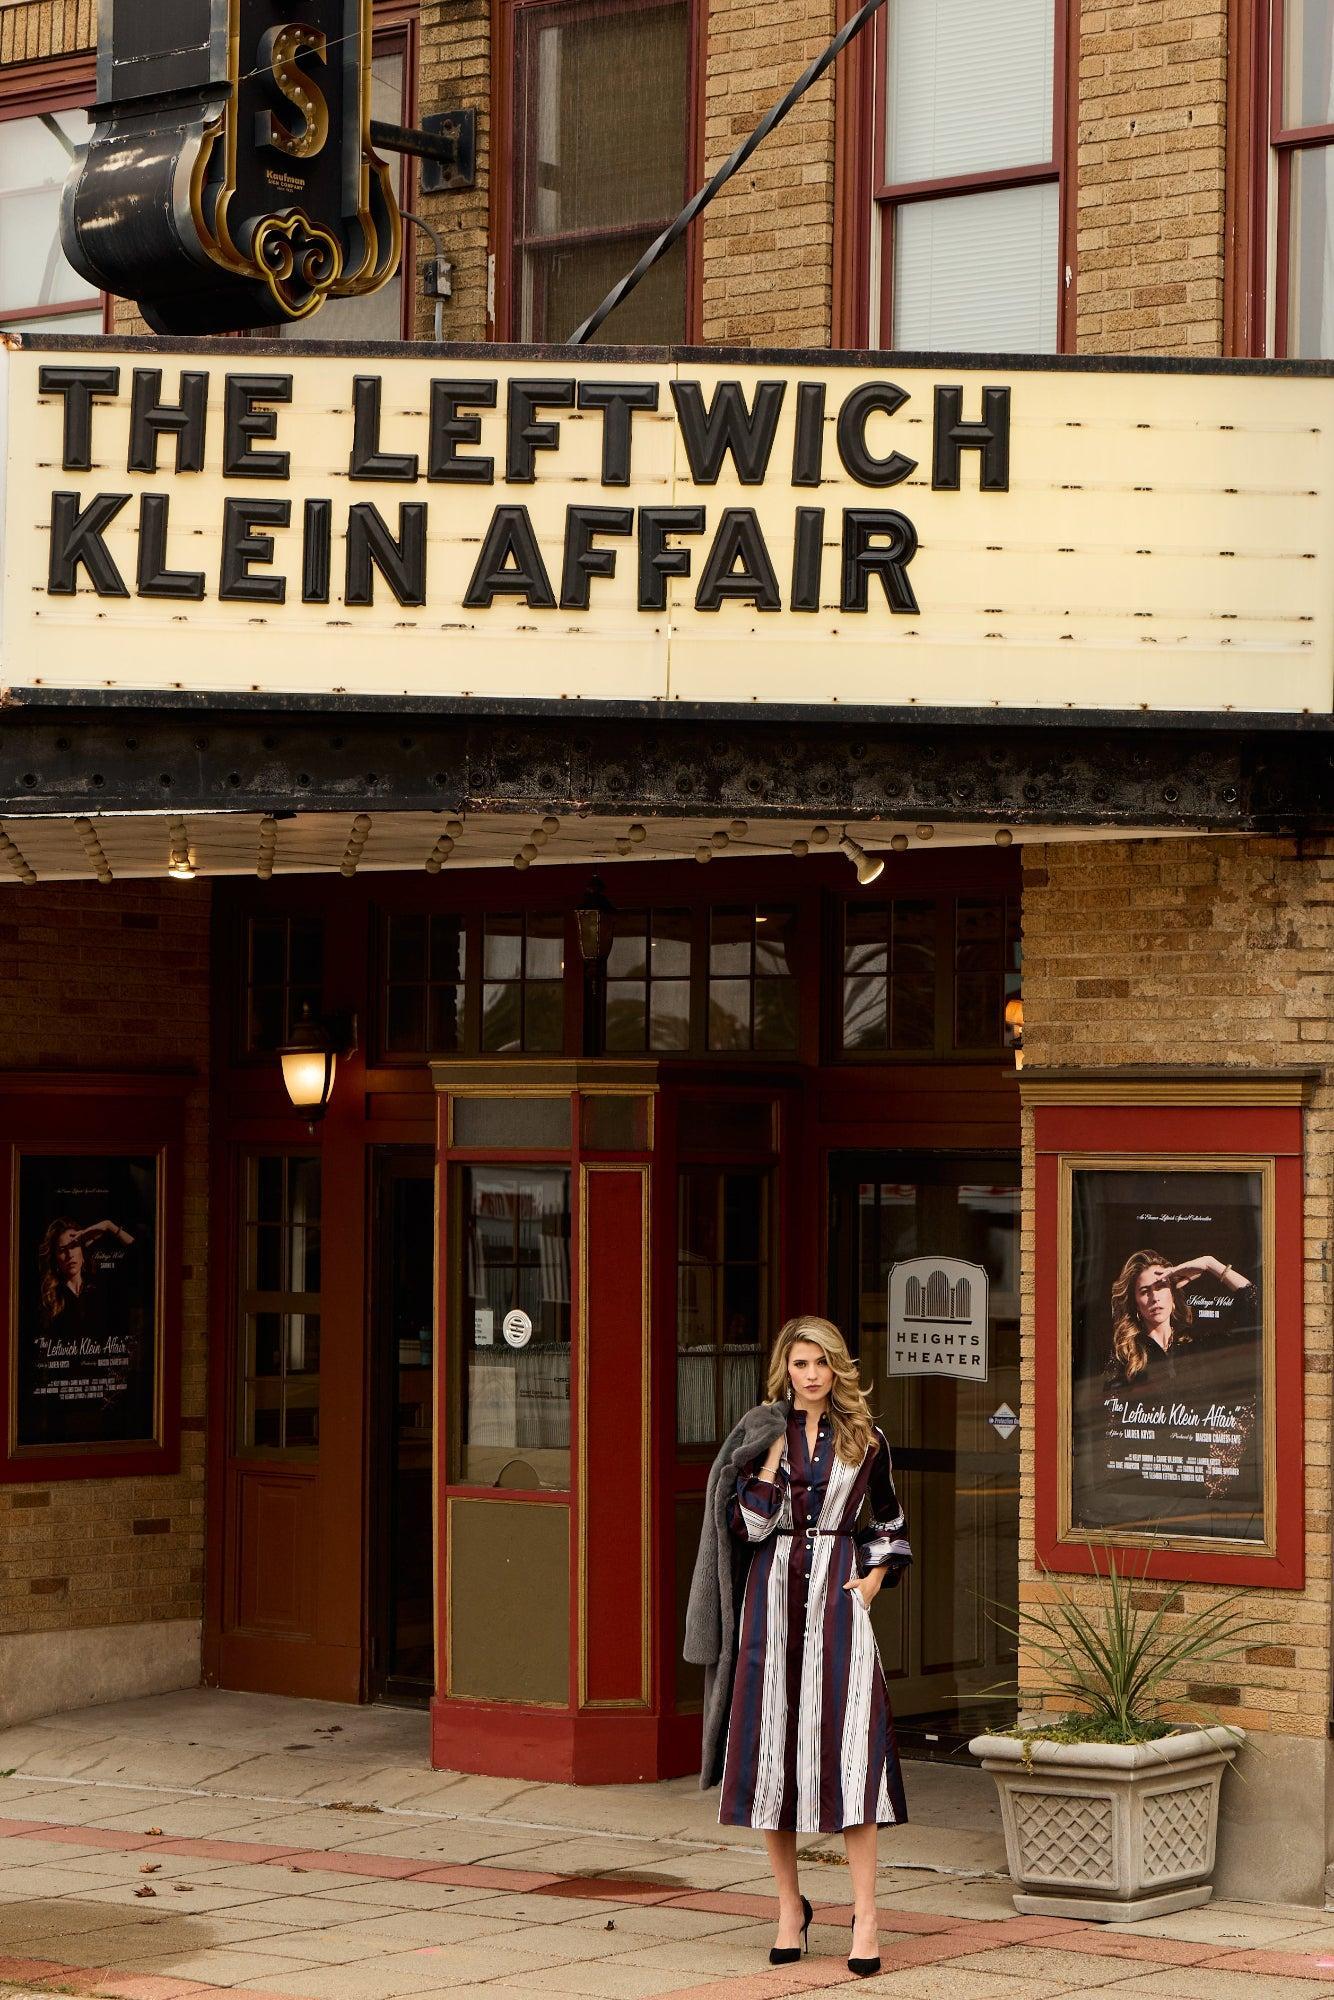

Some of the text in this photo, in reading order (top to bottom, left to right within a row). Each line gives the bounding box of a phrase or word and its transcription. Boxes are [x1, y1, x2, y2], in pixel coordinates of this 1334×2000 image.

[257, 23, 329, 158] S
[266, 169, 306, 186] Kaufman
[280, 181, 304, 191] COMPANY
[38, 365, 1011, 493] THE LEFTWICH
[47, 490, 920, 615] KLEIN AFFAIR
[47, 1338, 77, 1357] Leftwich
[79, 1337, 101, 1355] Klein
[897, 1332, 980, 1346] HEIGHTS
[895, 1351, 981, 1365] THEATER
[1121, 1401, 1167, 1424] Leftwich
[1168, 1403, 1201, 1426] Klein
